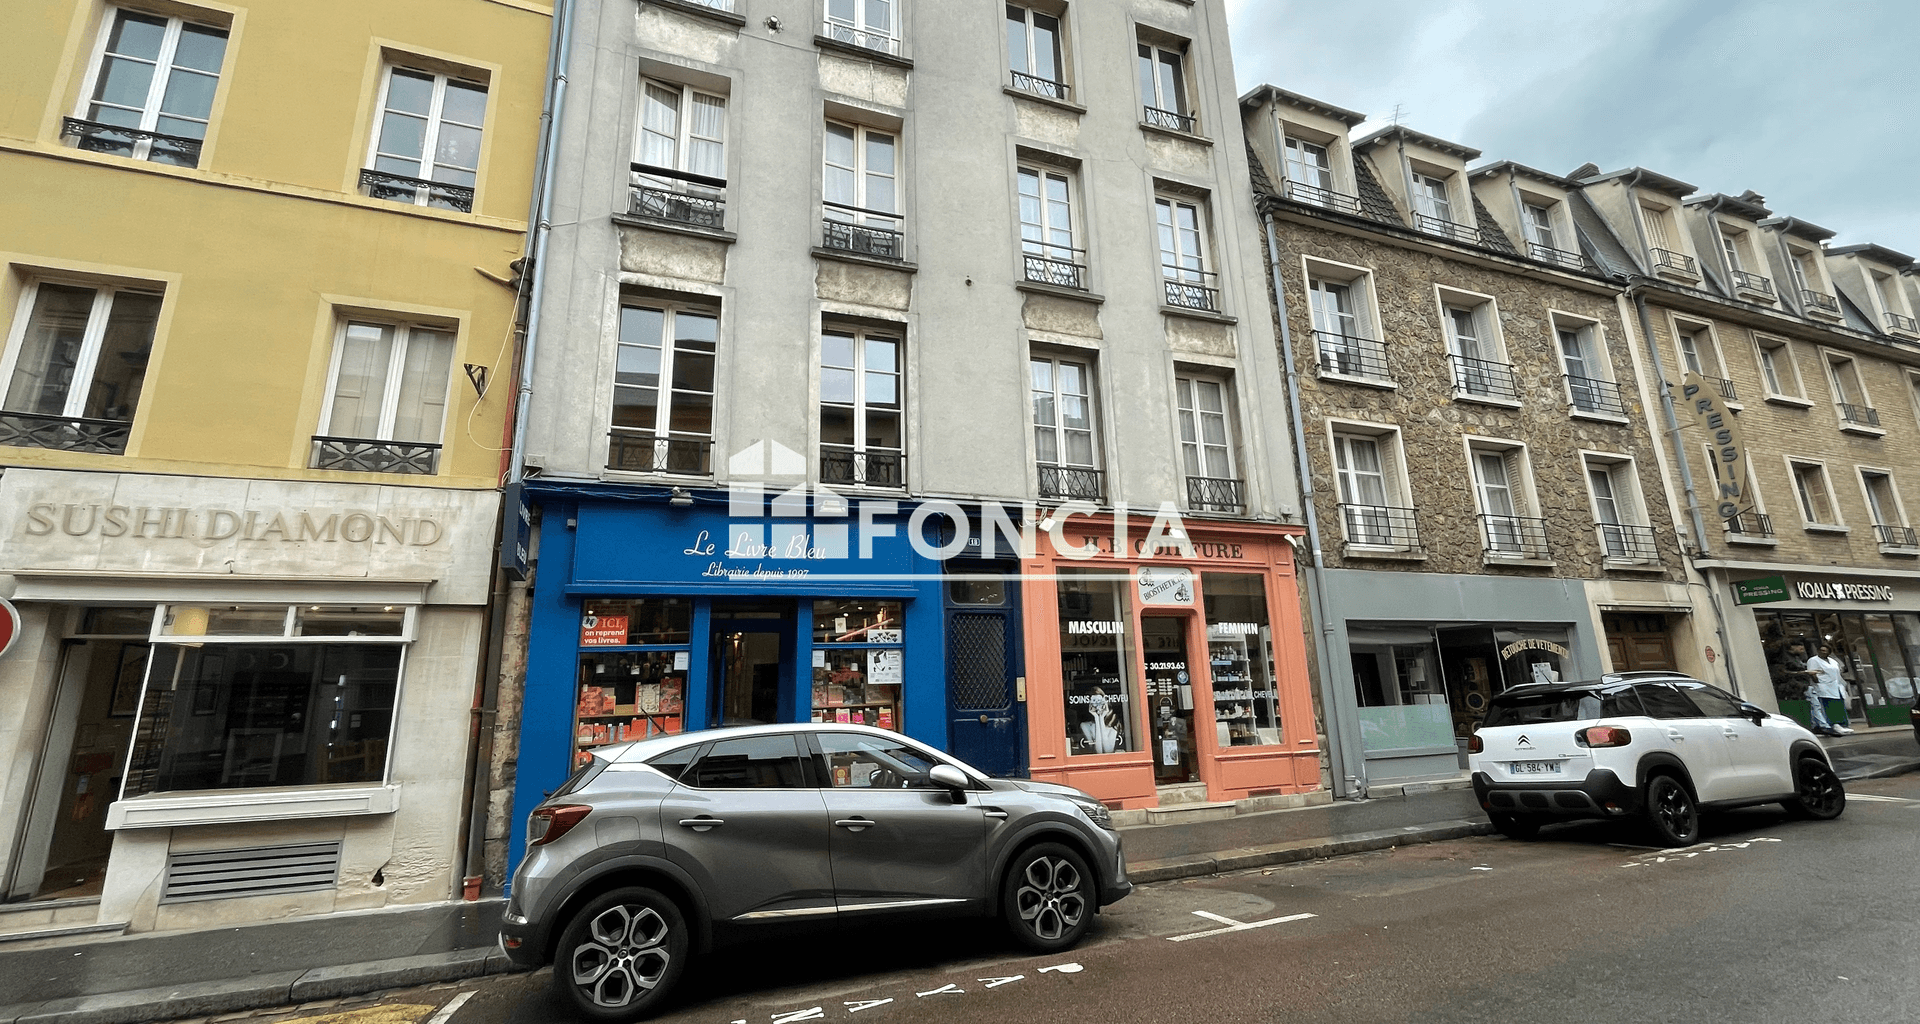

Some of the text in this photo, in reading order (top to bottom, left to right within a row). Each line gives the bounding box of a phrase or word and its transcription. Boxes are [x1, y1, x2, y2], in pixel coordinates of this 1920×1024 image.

[1683, 384, 1738, 518] PRESSING
[24, 502, 443, 546] SUSHI DIAMOND
[683, 529, 826, 559] Le Livre Bleu
[1134, 538, 1243, 559] COIFFURE
[702, 561, 809, 581] Librairie depuis 1997
[1143, 570, 1189, 601] BIOSTHETICIEN
[1743, 589, 1783, 597] PRESSING
[1797, 581, 1894, 601] KOALA PRESSING
[595, 629, 625, 637] reprend
[1068, 621, 1124, 634] MASCULIN
[1218, 622, 1258, 635] FEMININ
[1501, 639, 1528, 660] RETOUCHE
[1528, 639, 1536, 649] DE
[1069, 695, 1089, 704] SOINS
